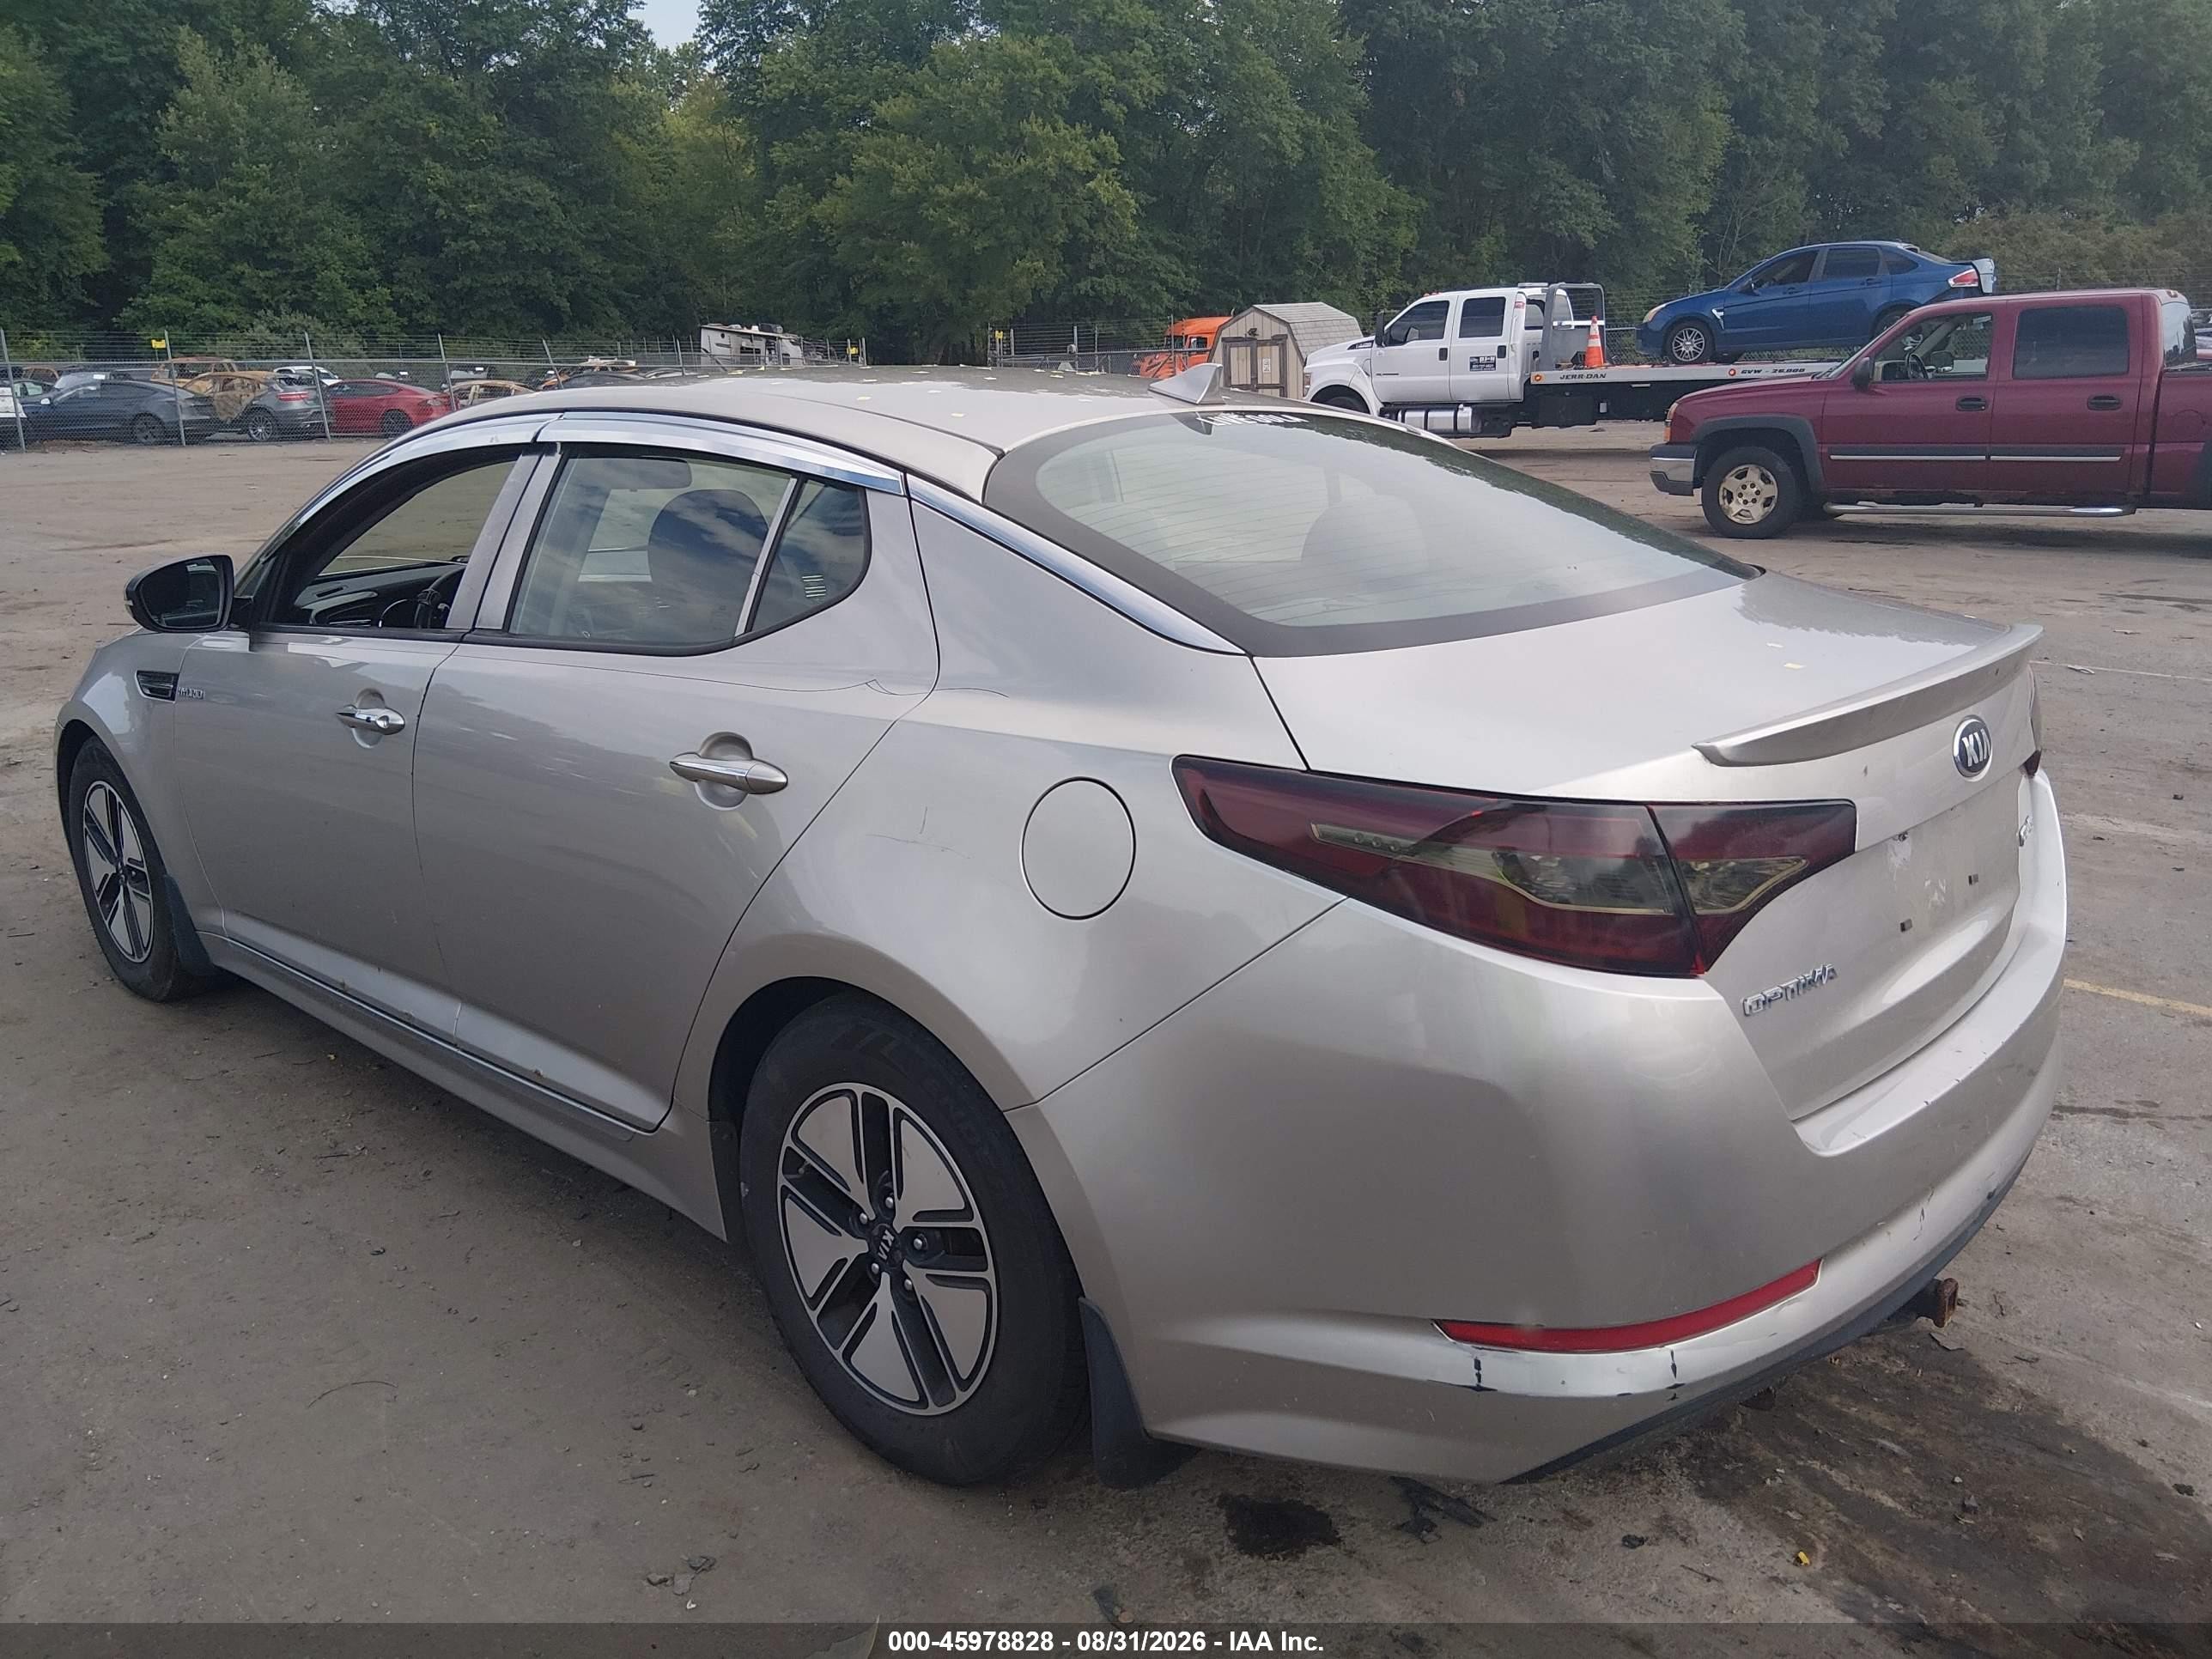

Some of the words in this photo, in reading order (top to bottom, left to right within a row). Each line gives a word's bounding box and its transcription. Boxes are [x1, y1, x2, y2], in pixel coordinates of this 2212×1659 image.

[1961, 728, 1990, 767] KIA
[1741, 963, 1838, 1017] OPTIMA
[878, 1229, 895, 1261] KIA
